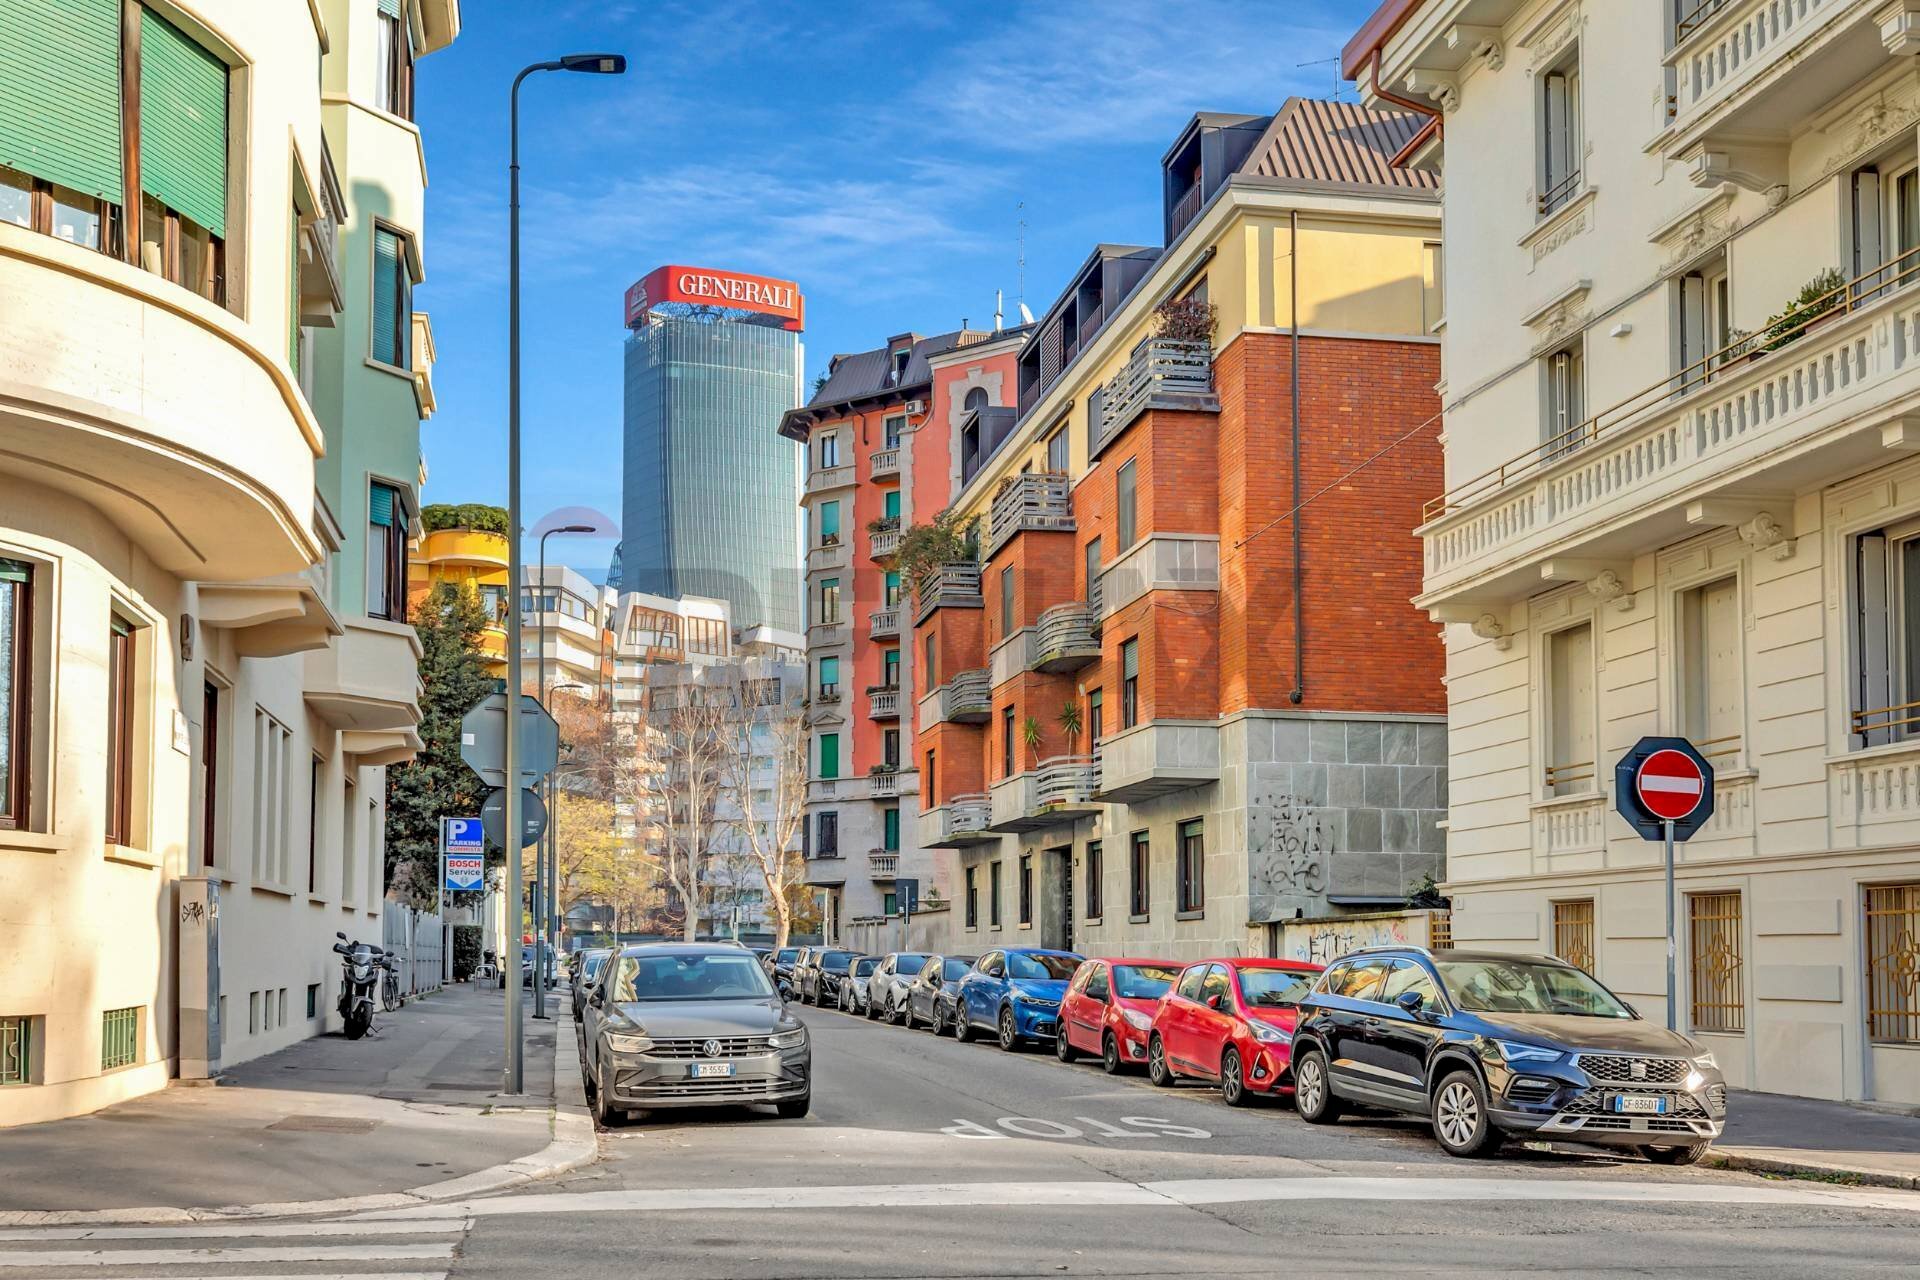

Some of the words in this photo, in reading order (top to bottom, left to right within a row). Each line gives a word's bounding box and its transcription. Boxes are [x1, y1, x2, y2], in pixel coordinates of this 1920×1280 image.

[679, 273, 793, 309] GENERALI
[449, 820, 468, 840] P
[940, 1116, 1213, 1139] STOP
